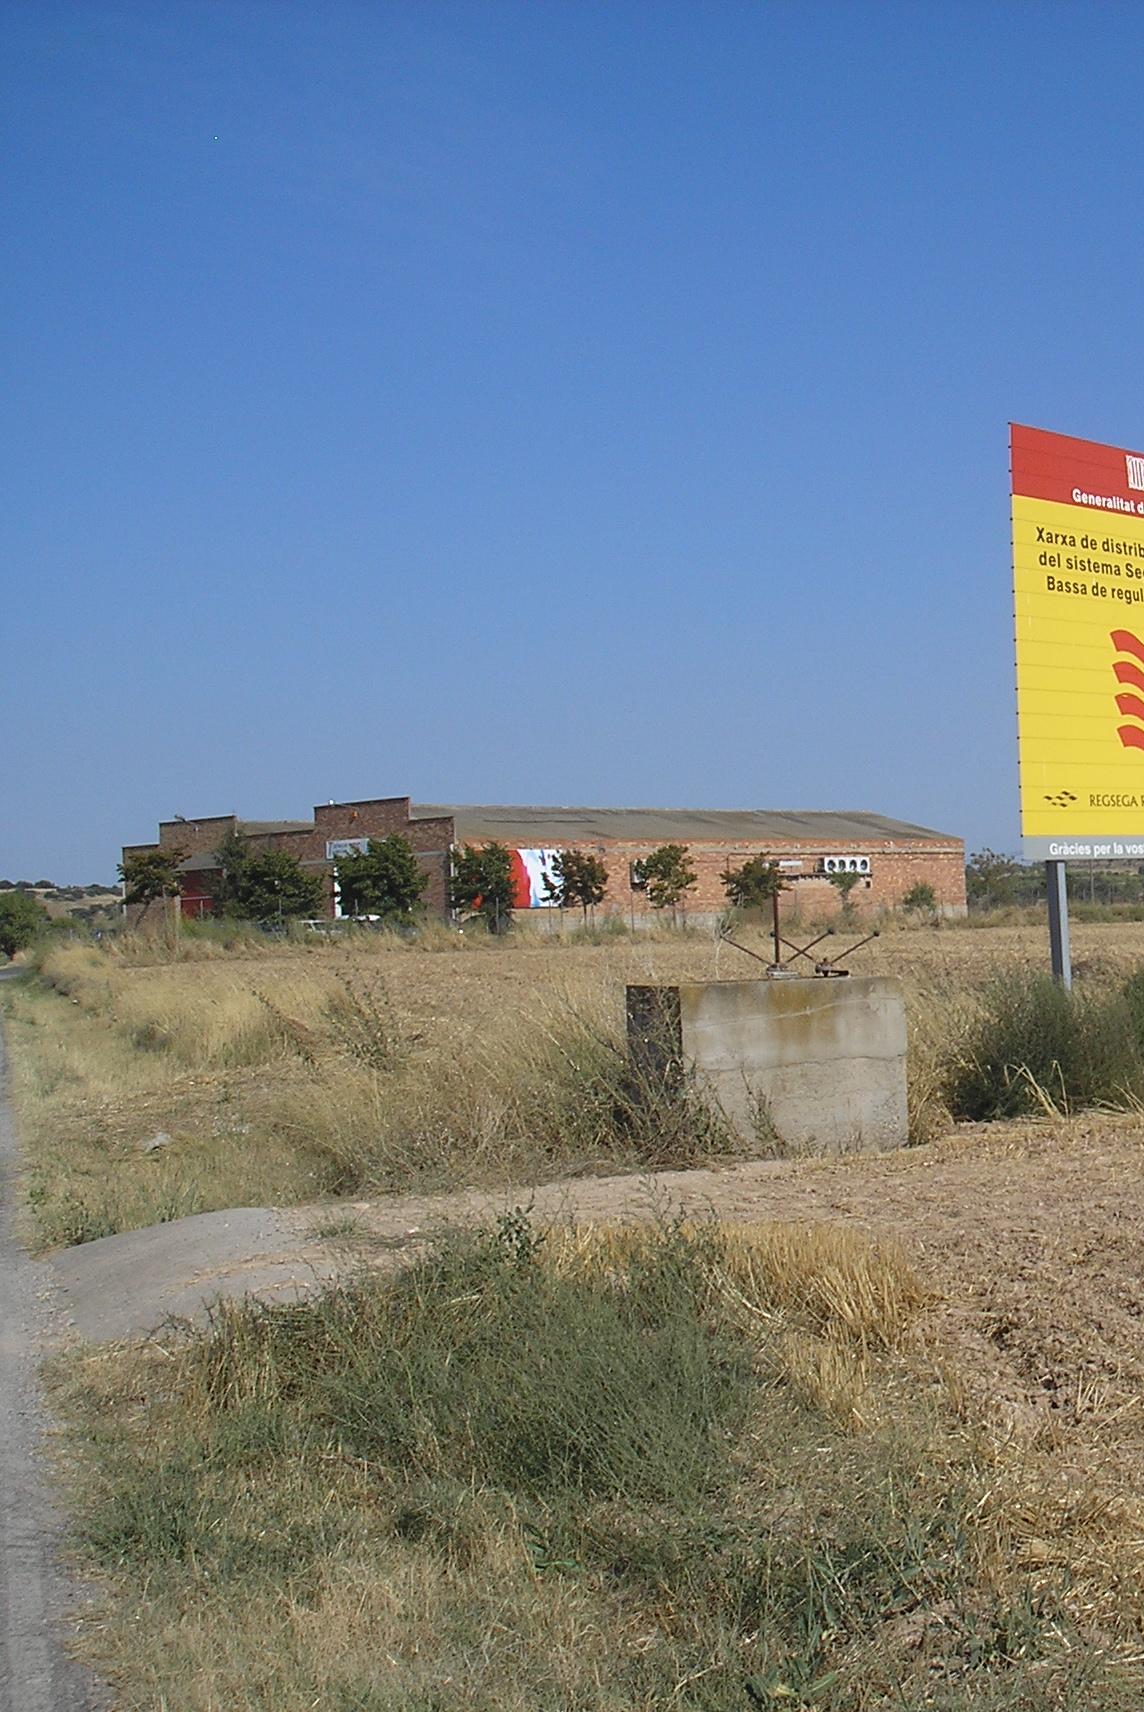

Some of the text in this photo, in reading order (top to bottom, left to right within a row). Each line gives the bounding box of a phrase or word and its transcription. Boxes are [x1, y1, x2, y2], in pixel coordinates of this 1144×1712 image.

[1072, 488, 1136, 513] Generalitat
[1036, 526, 1076, 547] Xarxa
[1081, 534, 1098, 550] de
[1039, 551, 1061, 568] del
[1066, 555, 1121, 576] sistema
[1047, 575, 1087, 595] Bassa
[1091, 582, 1107, 597] de
[1089, 794, 1139, 807] REGSEGA
[1049, 842, 1091, 856] Gràcies
[1093, 845, 1111, 858] per
[1113, 842, 1124, 854] la
